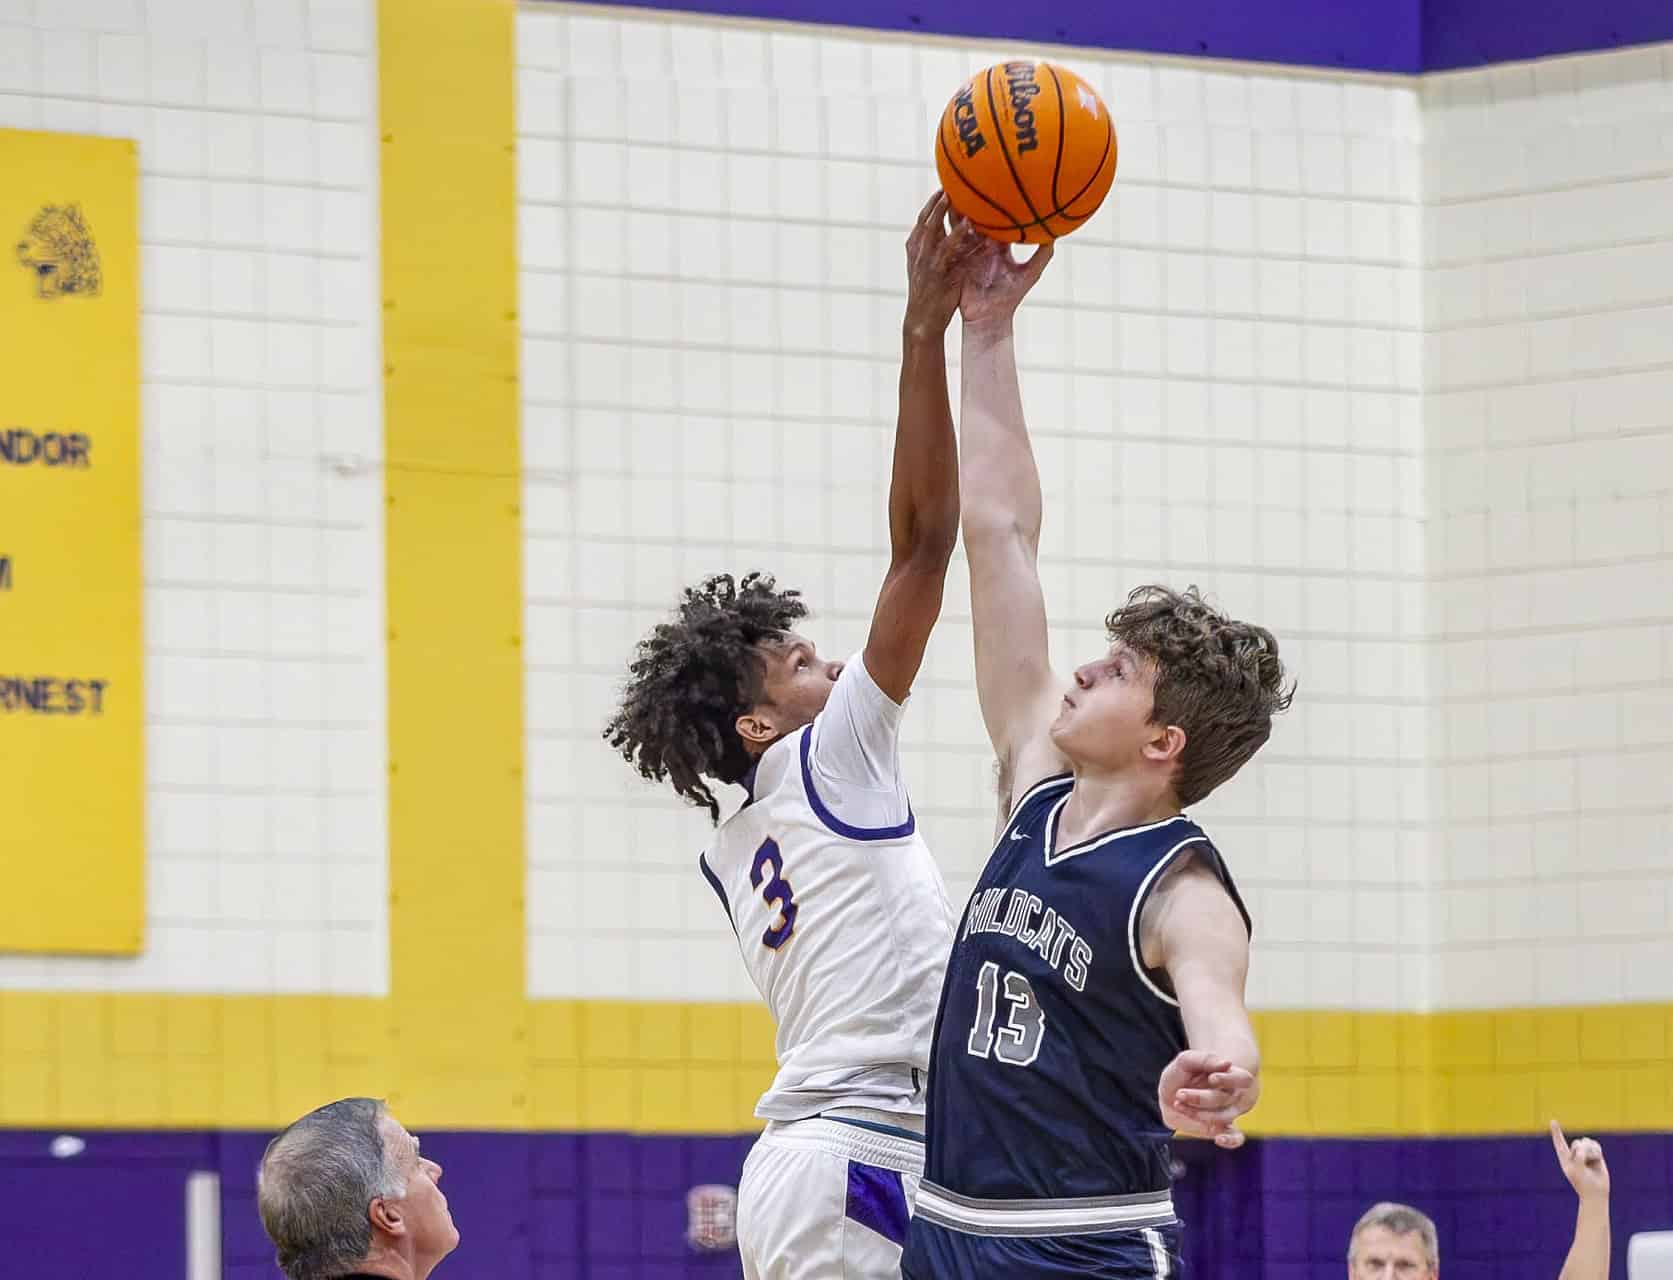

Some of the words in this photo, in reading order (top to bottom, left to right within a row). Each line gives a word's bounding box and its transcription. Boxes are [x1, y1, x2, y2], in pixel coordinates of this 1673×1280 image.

[749, 834, 799, 951] 3
[962, 887, 1092, 992] WILDCATS
[967, 960, 1046, 1067] 13
